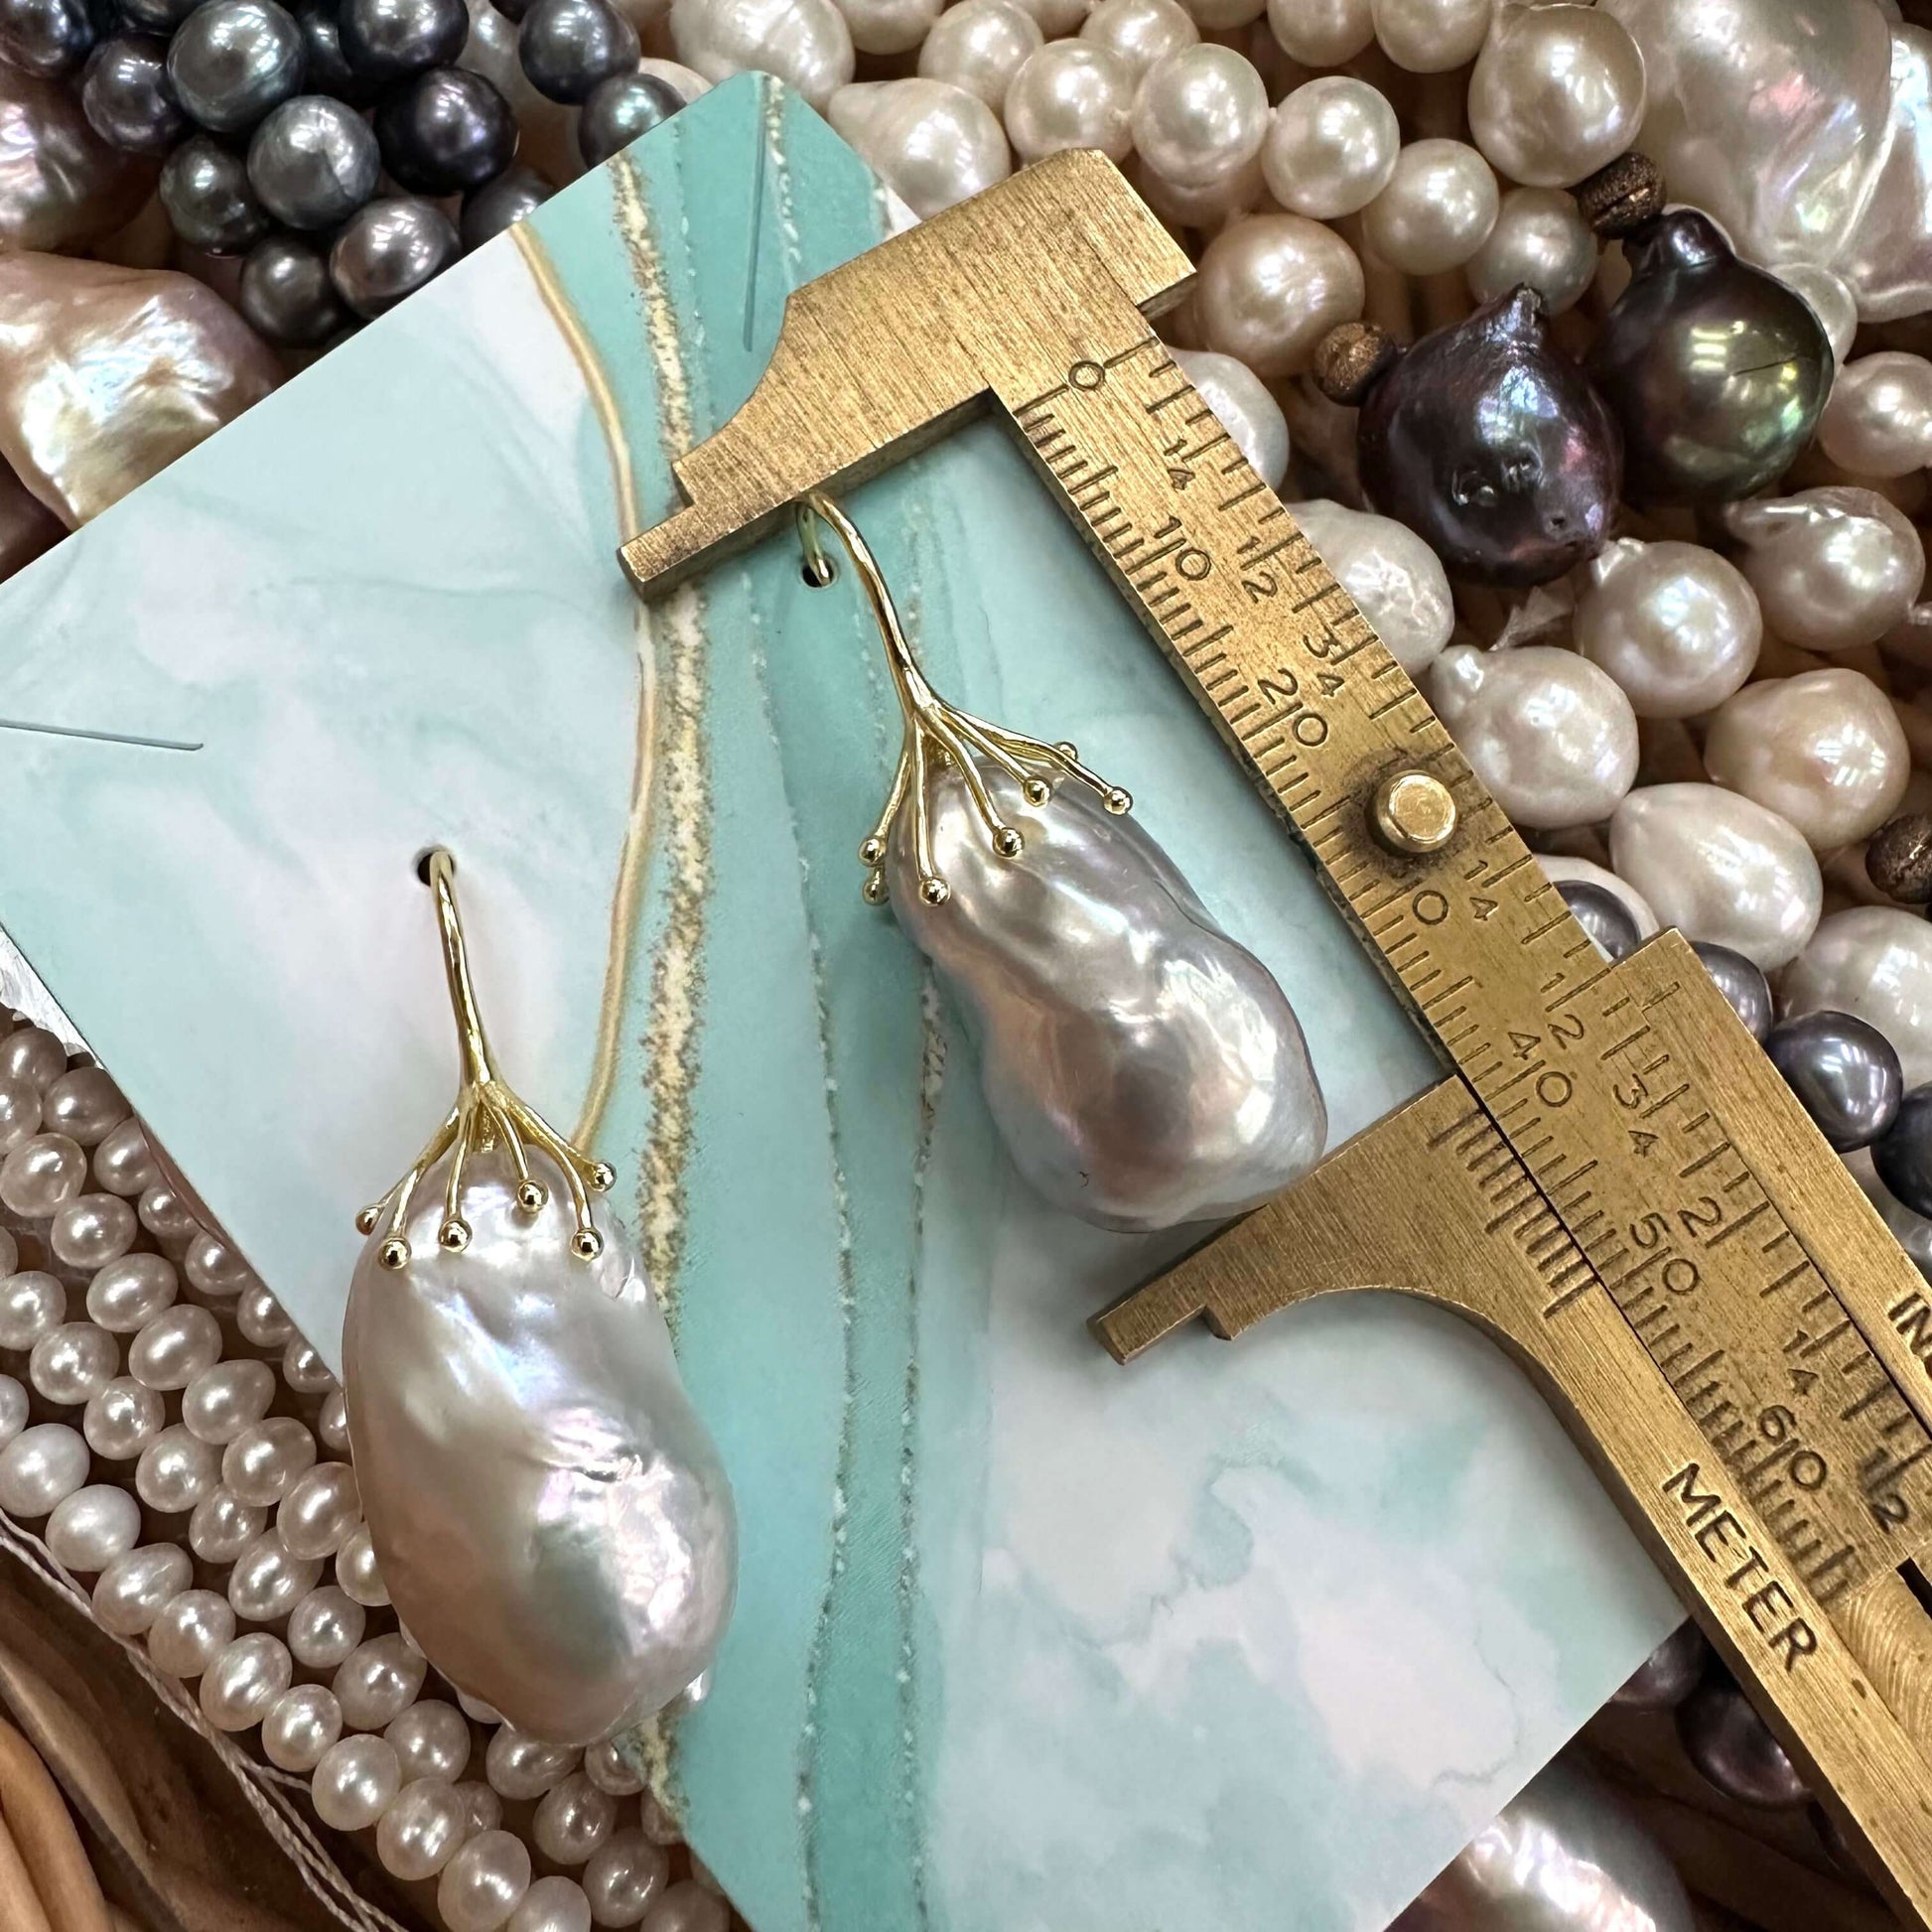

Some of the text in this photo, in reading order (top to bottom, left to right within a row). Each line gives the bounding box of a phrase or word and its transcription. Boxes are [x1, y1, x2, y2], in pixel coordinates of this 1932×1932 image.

[1067, 358, 1106, 391] 0
[1678, 1196, 1723, 1238] 2
[1887, 1291, 1932, 1382] IN
[1661, 1461, 1818, 1672] METER
